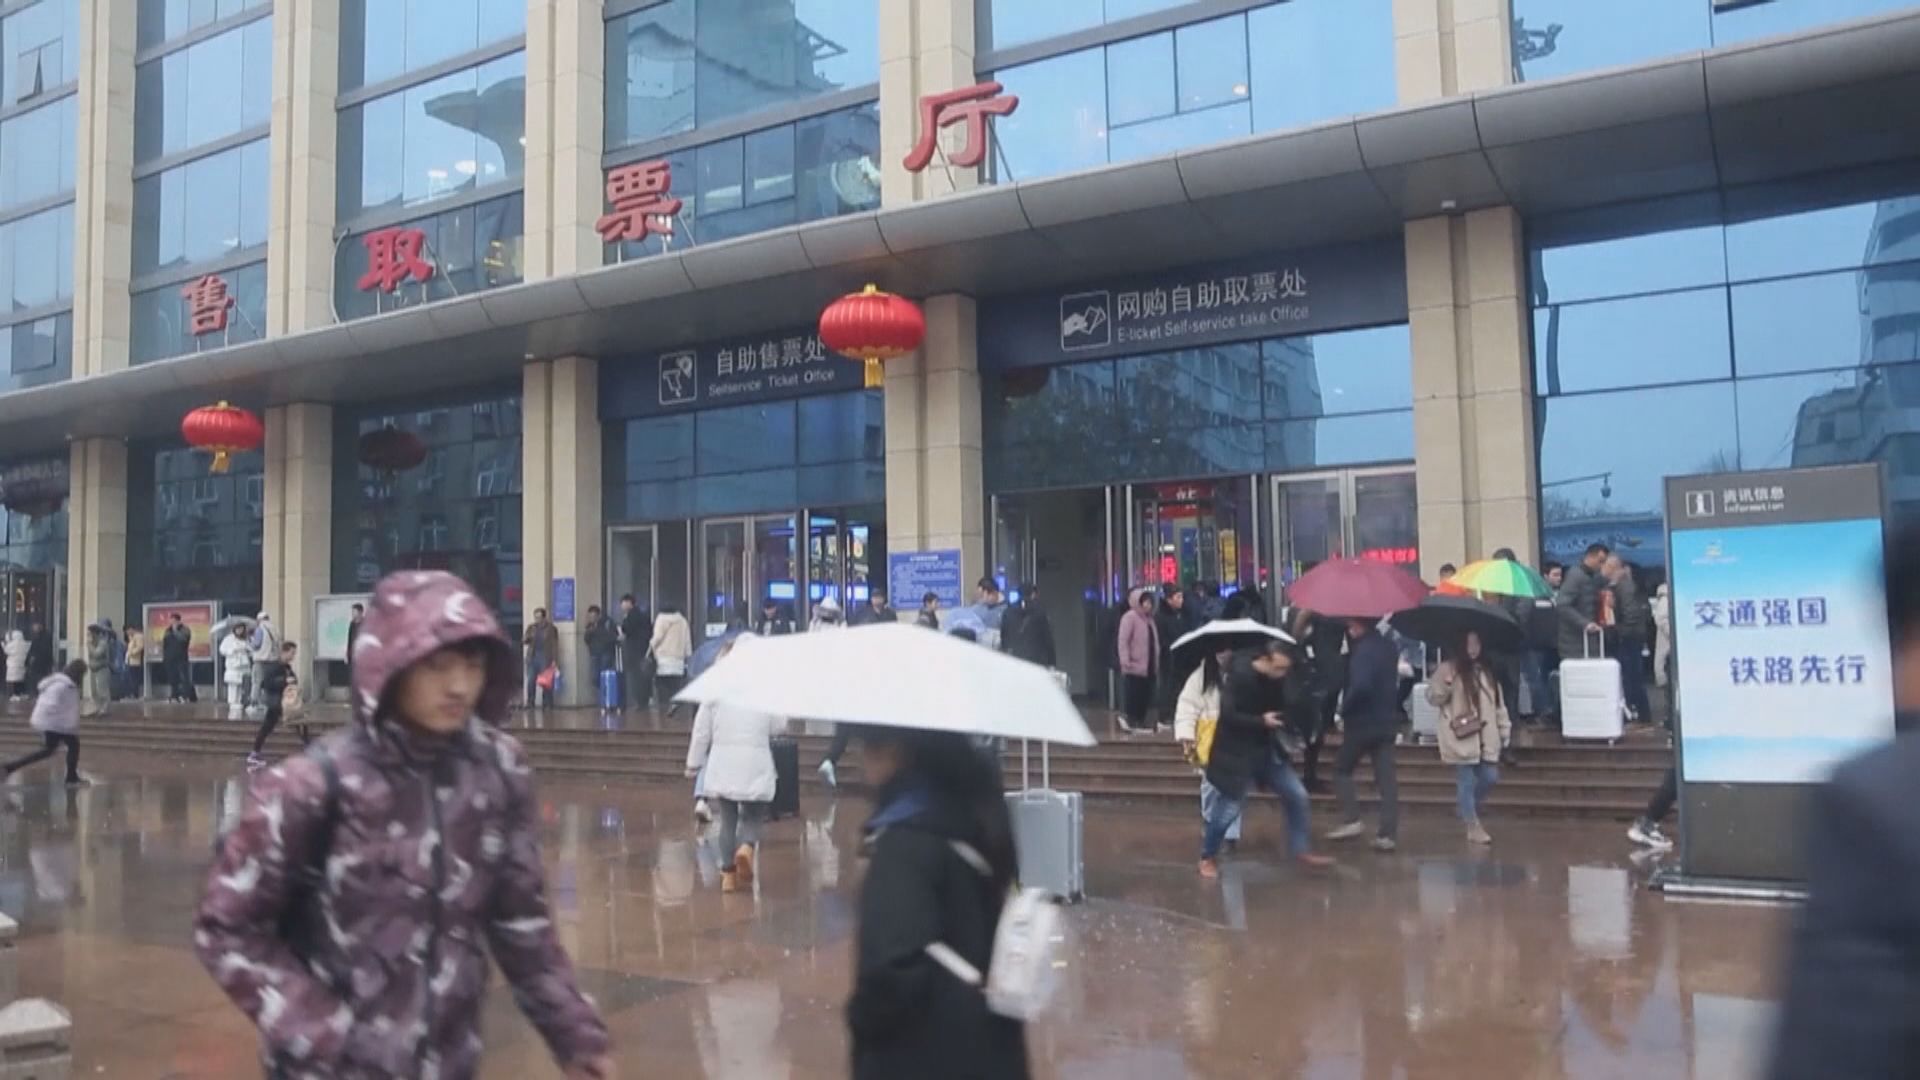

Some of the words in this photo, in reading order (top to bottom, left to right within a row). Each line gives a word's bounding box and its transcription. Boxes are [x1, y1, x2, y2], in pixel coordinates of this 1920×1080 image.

[1116, 268, 1307, 321] 网购自助取票处
[1117, 323, 1162, 343] E-ticket
[1164, 314, 1236, 337] Self-service
[1240, 309, 1267, 326] take
[1270, 304, 1310, 323] Office
[716, 335, 827, 377] 自助售票处
[768, 374, 799, 389] Ticket
[803, 368, 835, 384] Office
[1723, 486, 1785, 503] 资讯信息
[1723, 501, 1785, 513] Information
[1694, 597, 1827, 629] 交通强国
[1729, 655, 1867, 685] 铁路先行
